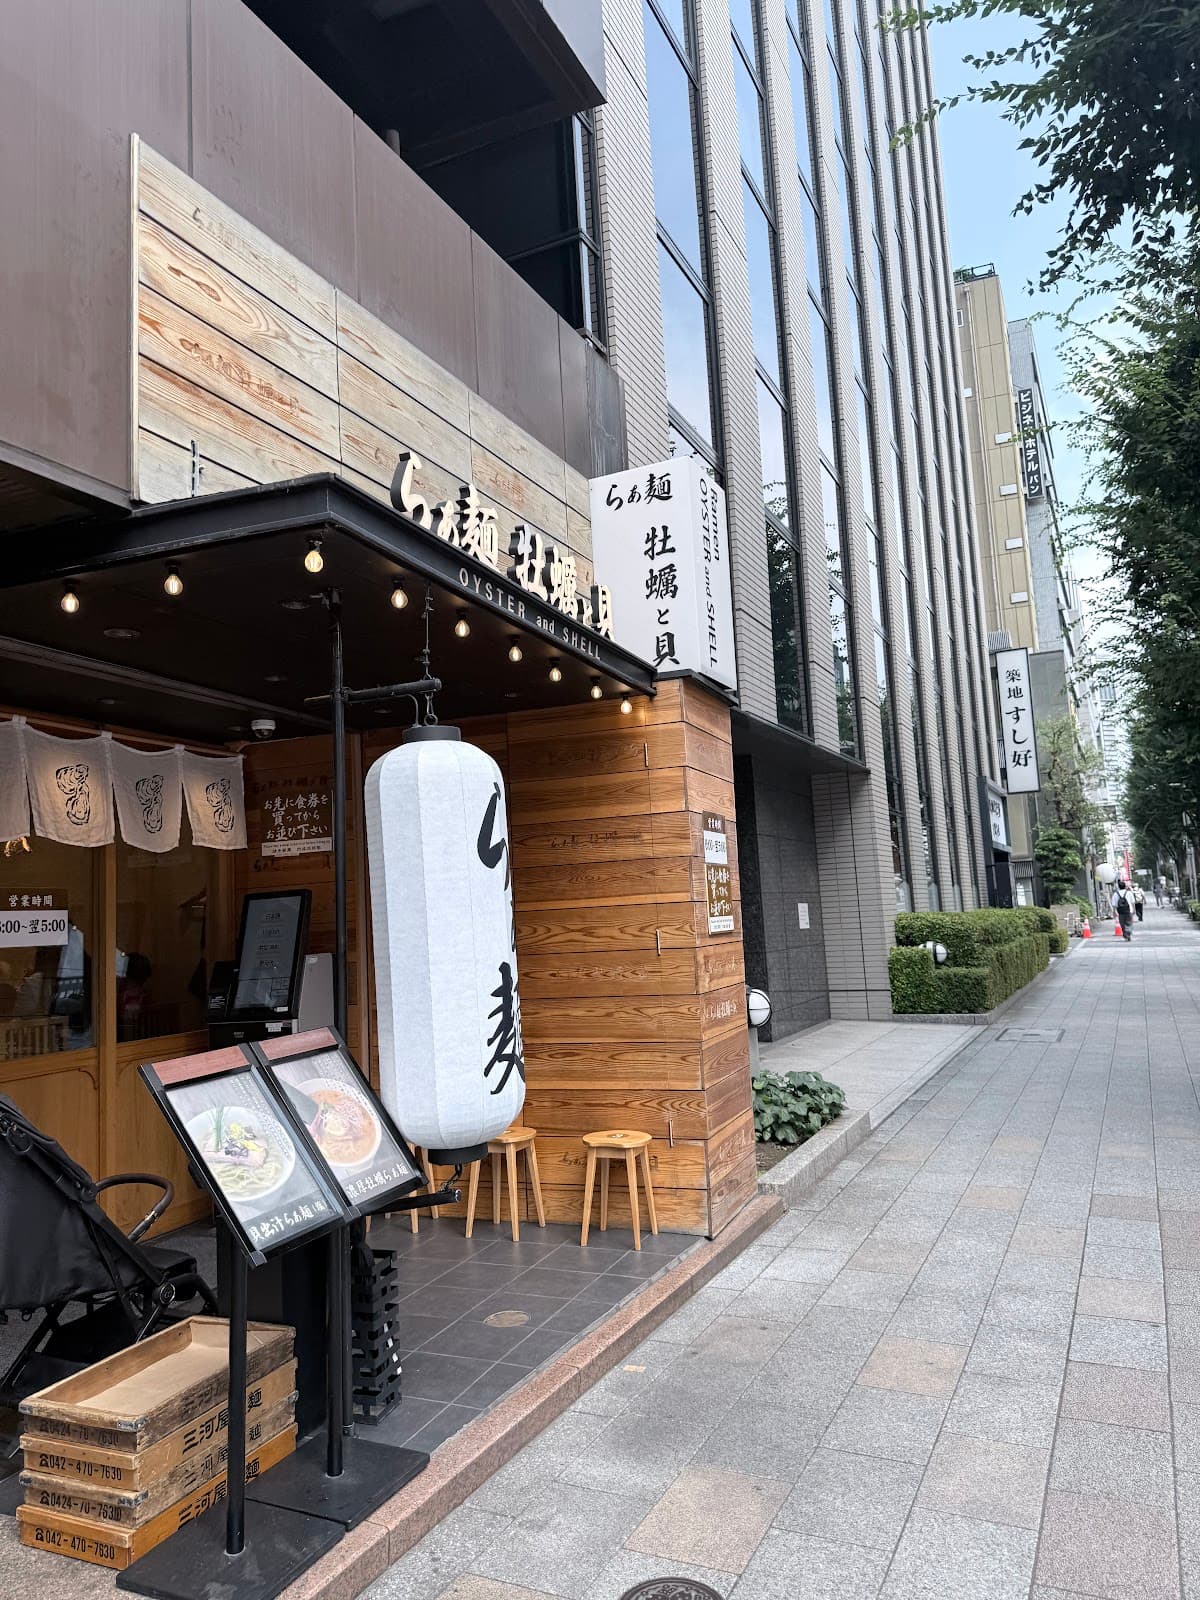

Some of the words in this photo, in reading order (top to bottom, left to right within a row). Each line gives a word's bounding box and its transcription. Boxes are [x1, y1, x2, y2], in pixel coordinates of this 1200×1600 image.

[606, 473, 674, 511] らぁ麺
[699, 477, 712, 564] OYSTER
[710, 487, 720, 561] Ramen
[644, 525, 681, 668] 牡蠣と貝
[704, 565, 712, 598] and
[458, 566, 526, 620] OYSTER
[536, 614, 556, 634] and
[563, 627, 601, 660] SHELL
[706, 602, 718, 669] SHELL
[266, 824, 328, 841] お並び下さい
[271, 810, 320, 826] 買ってから
[9, 895, 53, 907] 営業時間
